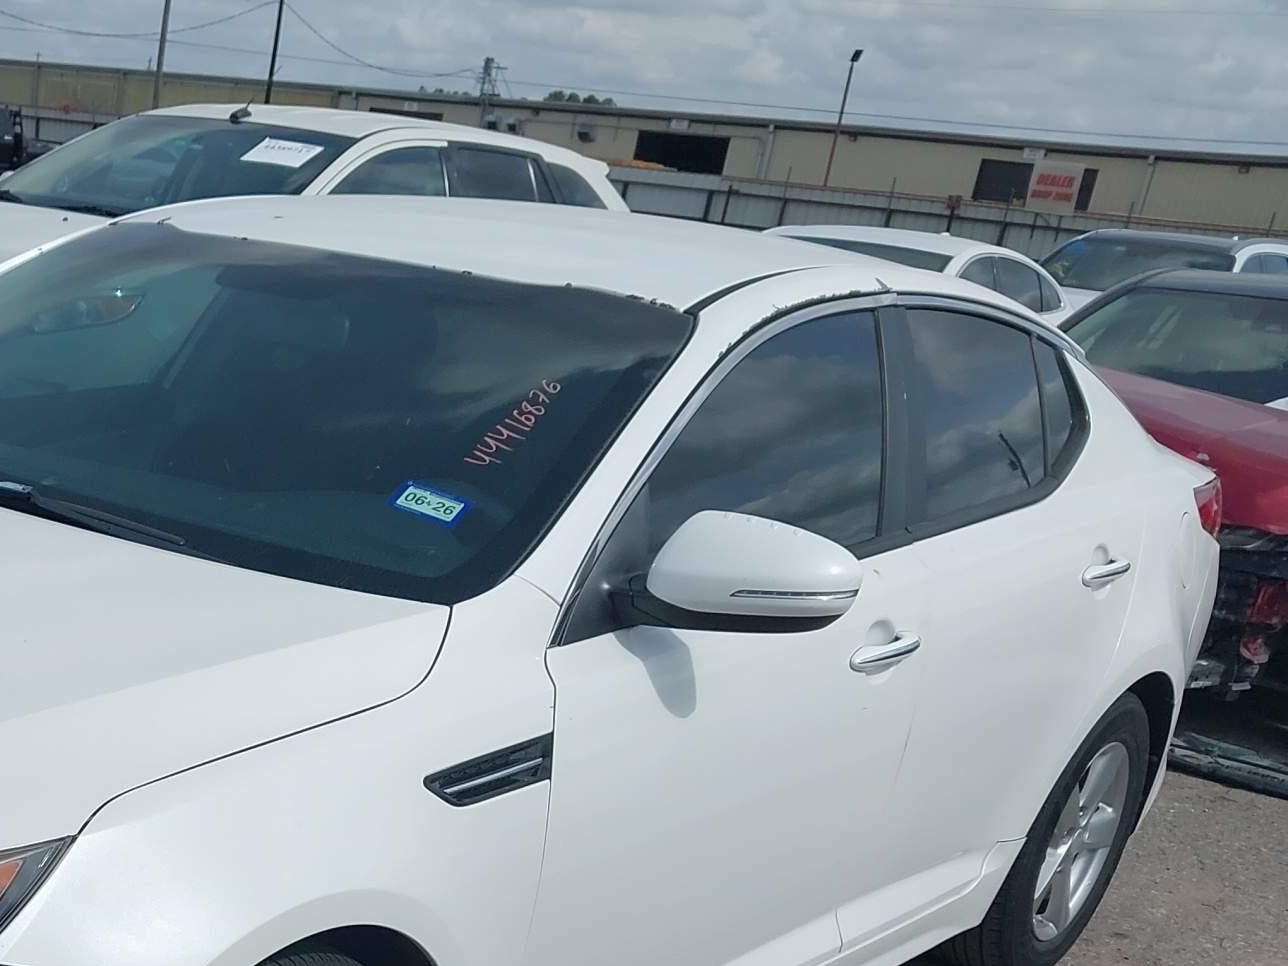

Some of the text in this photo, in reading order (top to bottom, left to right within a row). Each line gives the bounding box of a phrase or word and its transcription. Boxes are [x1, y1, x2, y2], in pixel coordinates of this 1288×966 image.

[464, 379, 561, 465] 44416876
[404, 492, 457, 516] 06 26
